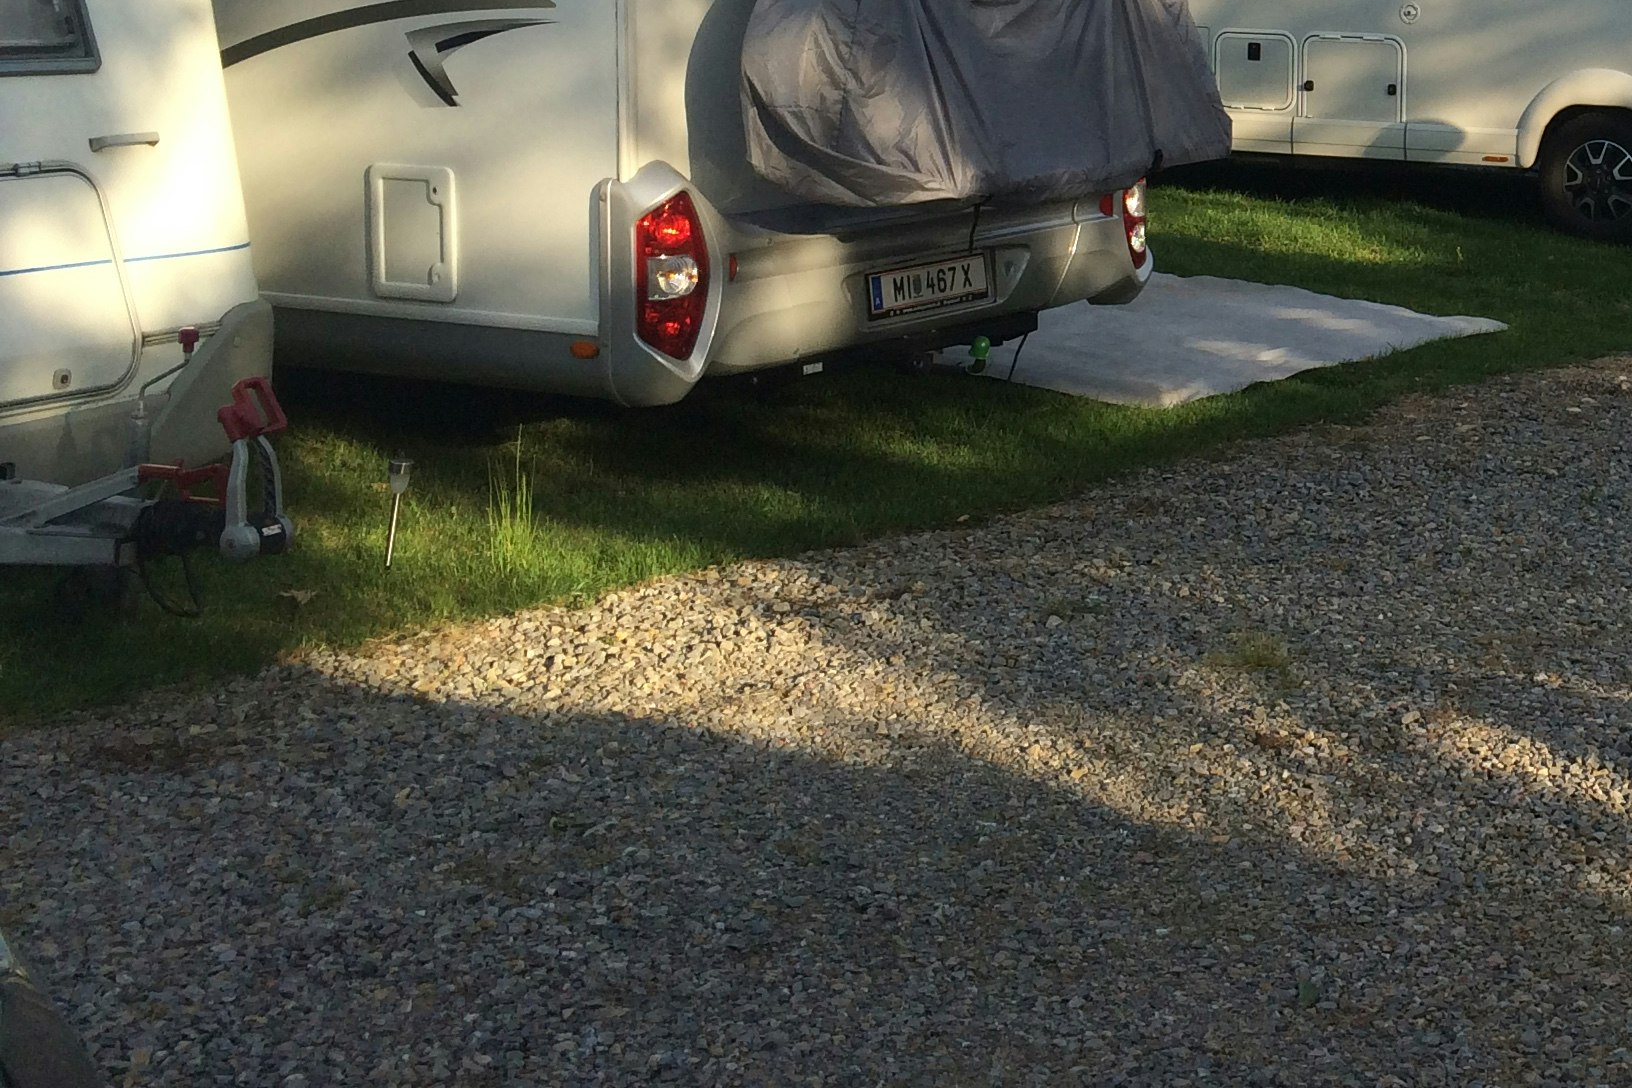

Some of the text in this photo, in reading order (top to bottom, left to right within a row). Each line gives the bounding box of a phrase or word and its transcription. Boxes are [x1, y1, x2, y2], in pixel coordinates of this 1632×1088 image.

[892, 274, 912, 303] MI
[926, 266, 957, 295] 467
[961, 262, 973, 289] X
